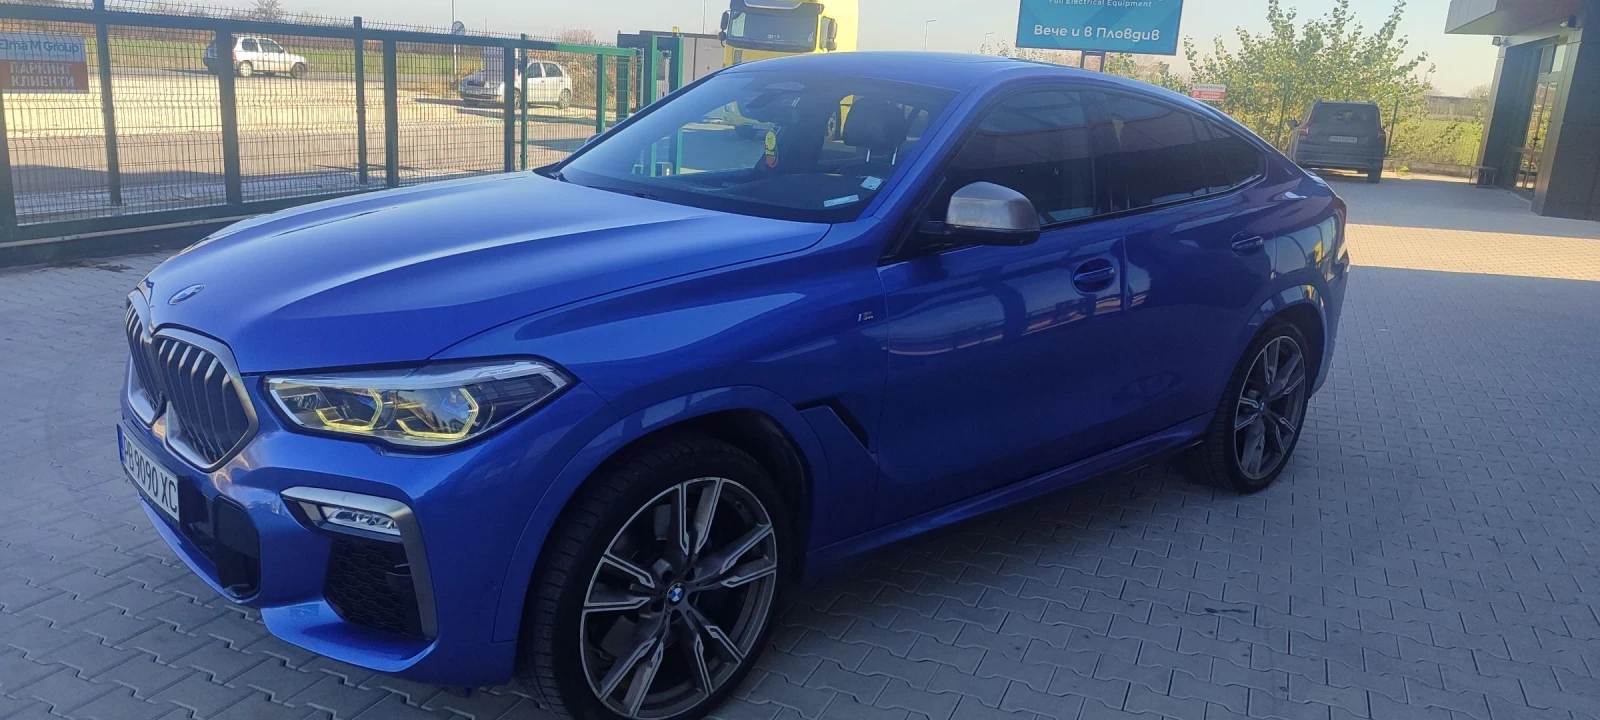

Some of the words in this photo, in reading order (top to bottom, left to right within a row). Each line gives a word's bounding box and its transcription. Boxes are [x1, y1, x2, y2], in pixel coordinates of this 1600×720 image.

[1107, 0, 1152, 8] Equipment
[1033, 24, 1068, 37] Вече
[1071, 27, 1080, 37] и
[1084, 26, 1092, 38] в
[1096, 27, 1160, 43] Пловдив
[30, 40, 41, 51] M
[43, 41, 80, 53] Group
[9, 61, 72, 74] ПАРКИНГ
[11, 75, 74, 87] КЛИЕНТИ
[134, 449, 159, 498] 9090
[160, 471, 177, 514] XC
